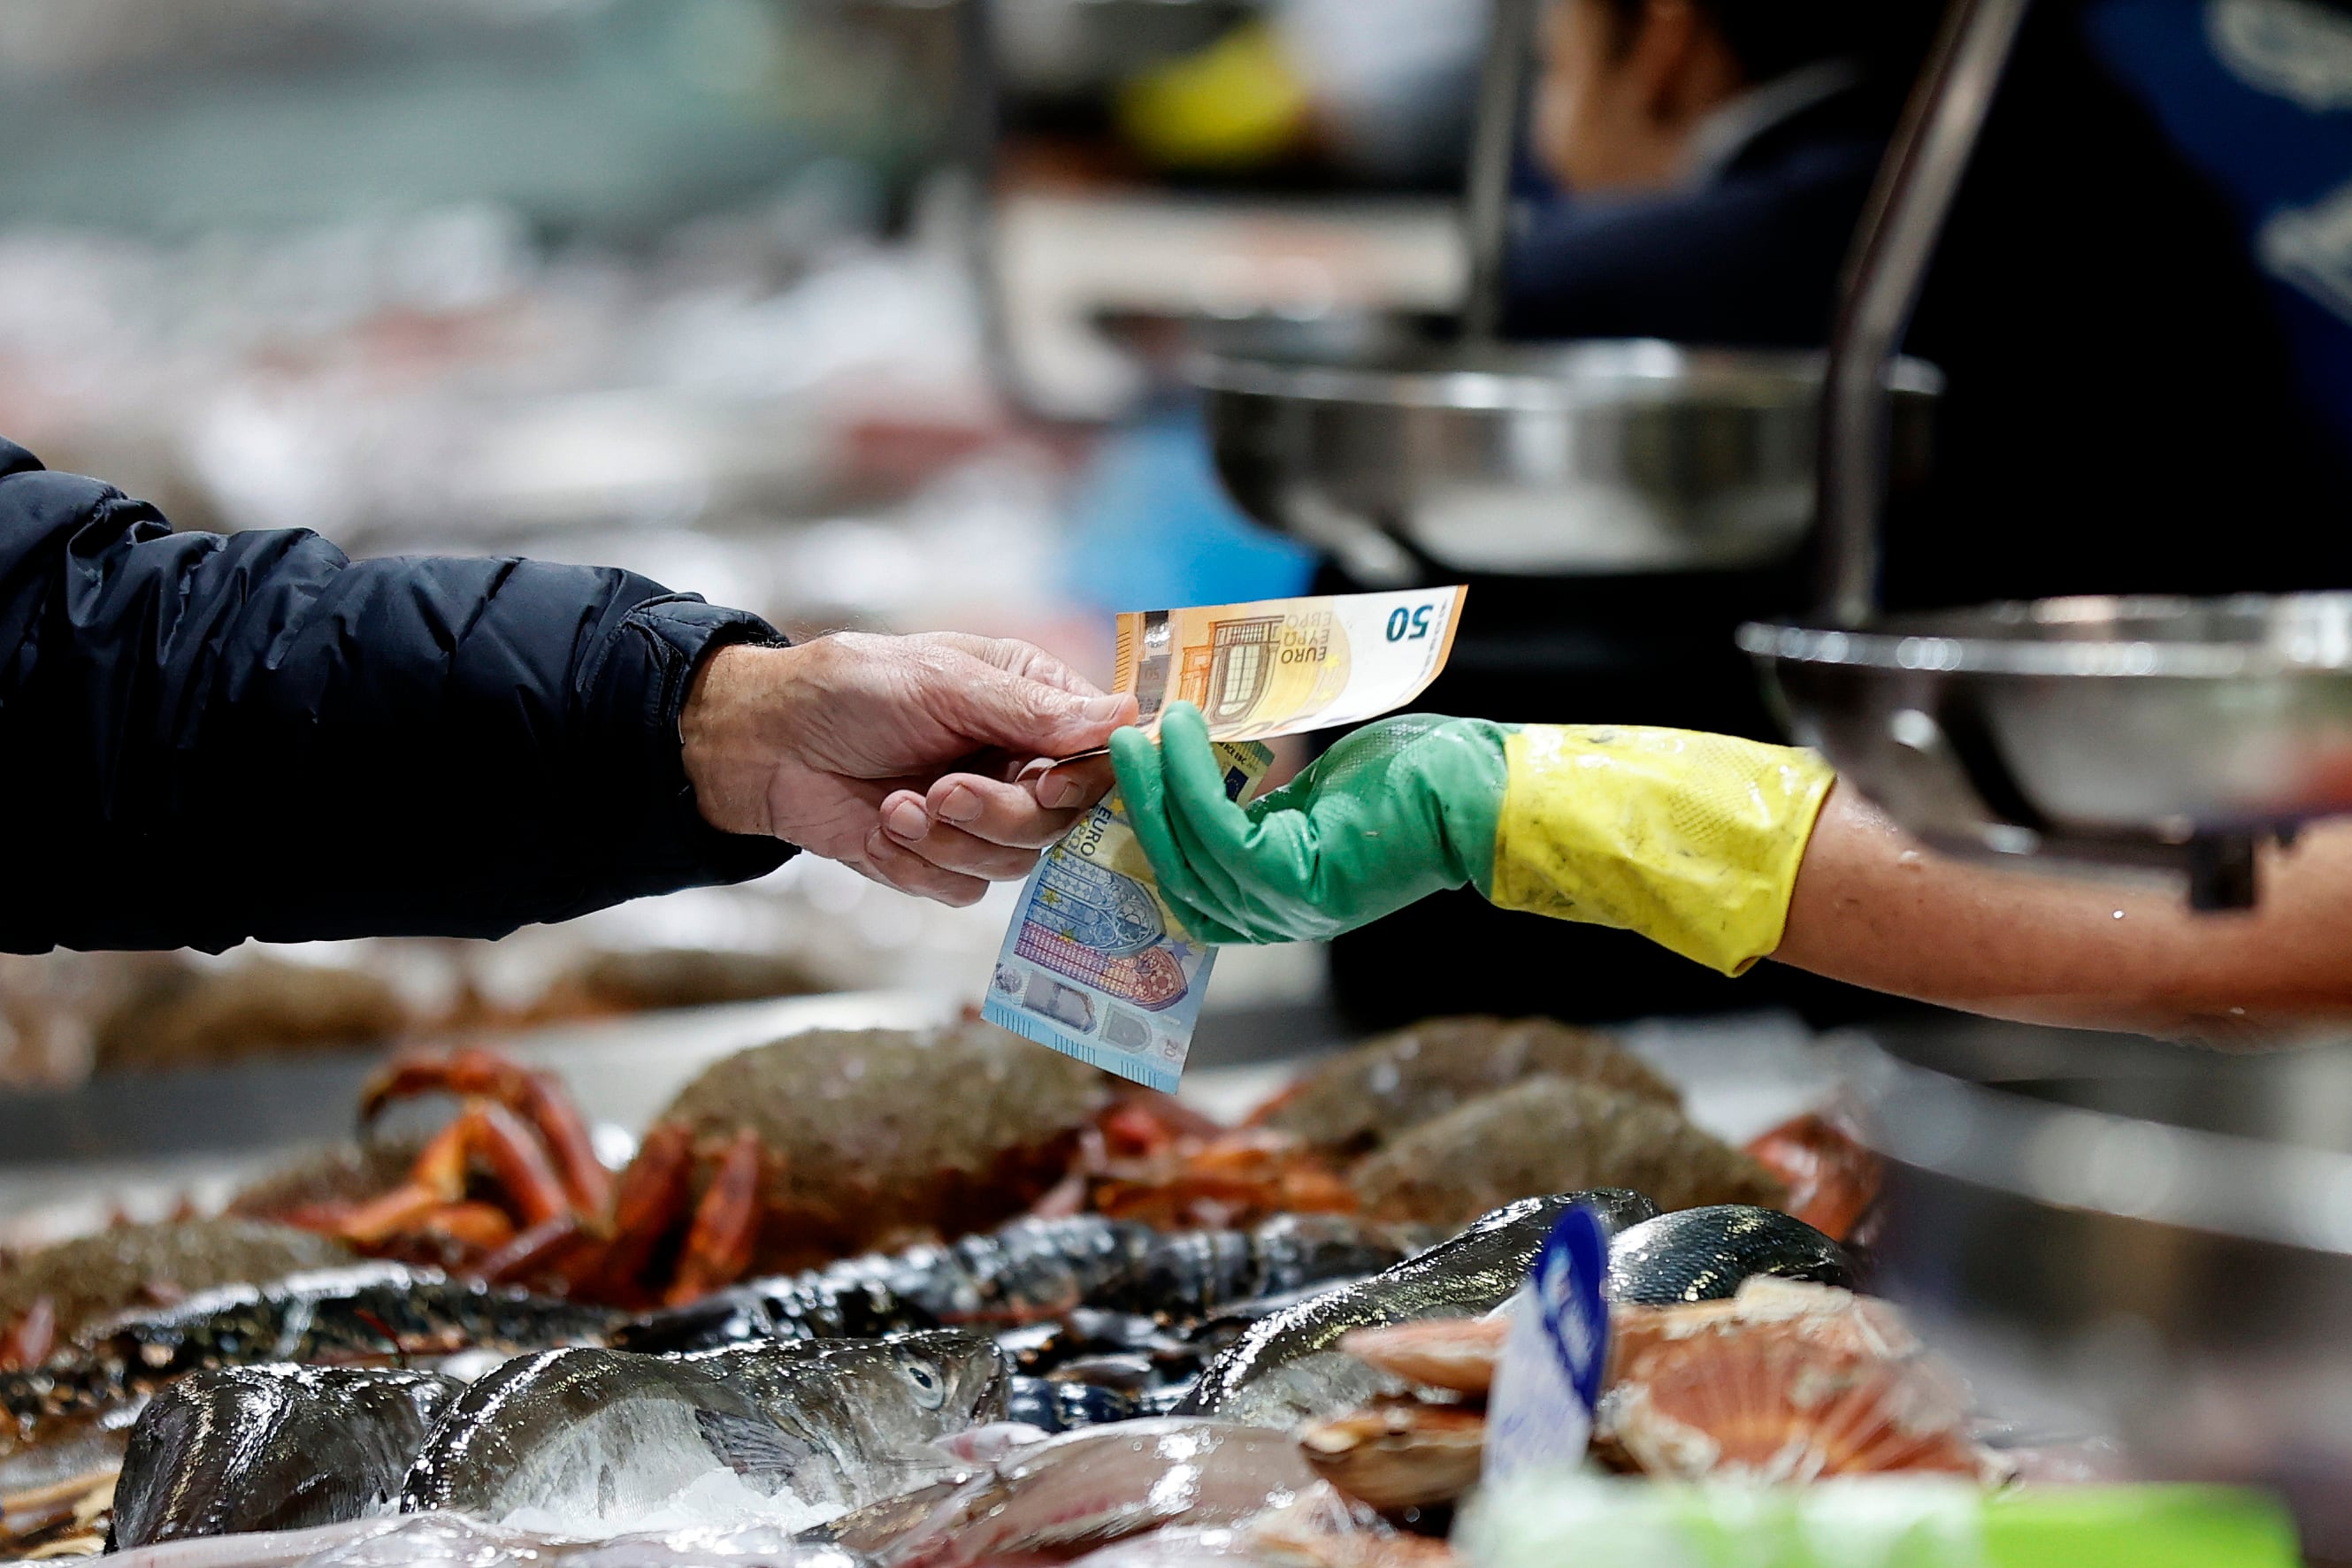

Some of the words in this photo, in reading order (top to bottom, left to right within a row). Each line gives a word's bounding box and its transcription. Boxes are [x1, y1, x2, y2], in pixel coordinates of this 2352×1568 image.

[1386, 605, 1434, 643] 50
[1281, 646, 1328, 665] EURO
[1080, 807, 1113, 857] EURO
[1165, 1039, 1178, 1058] 20
